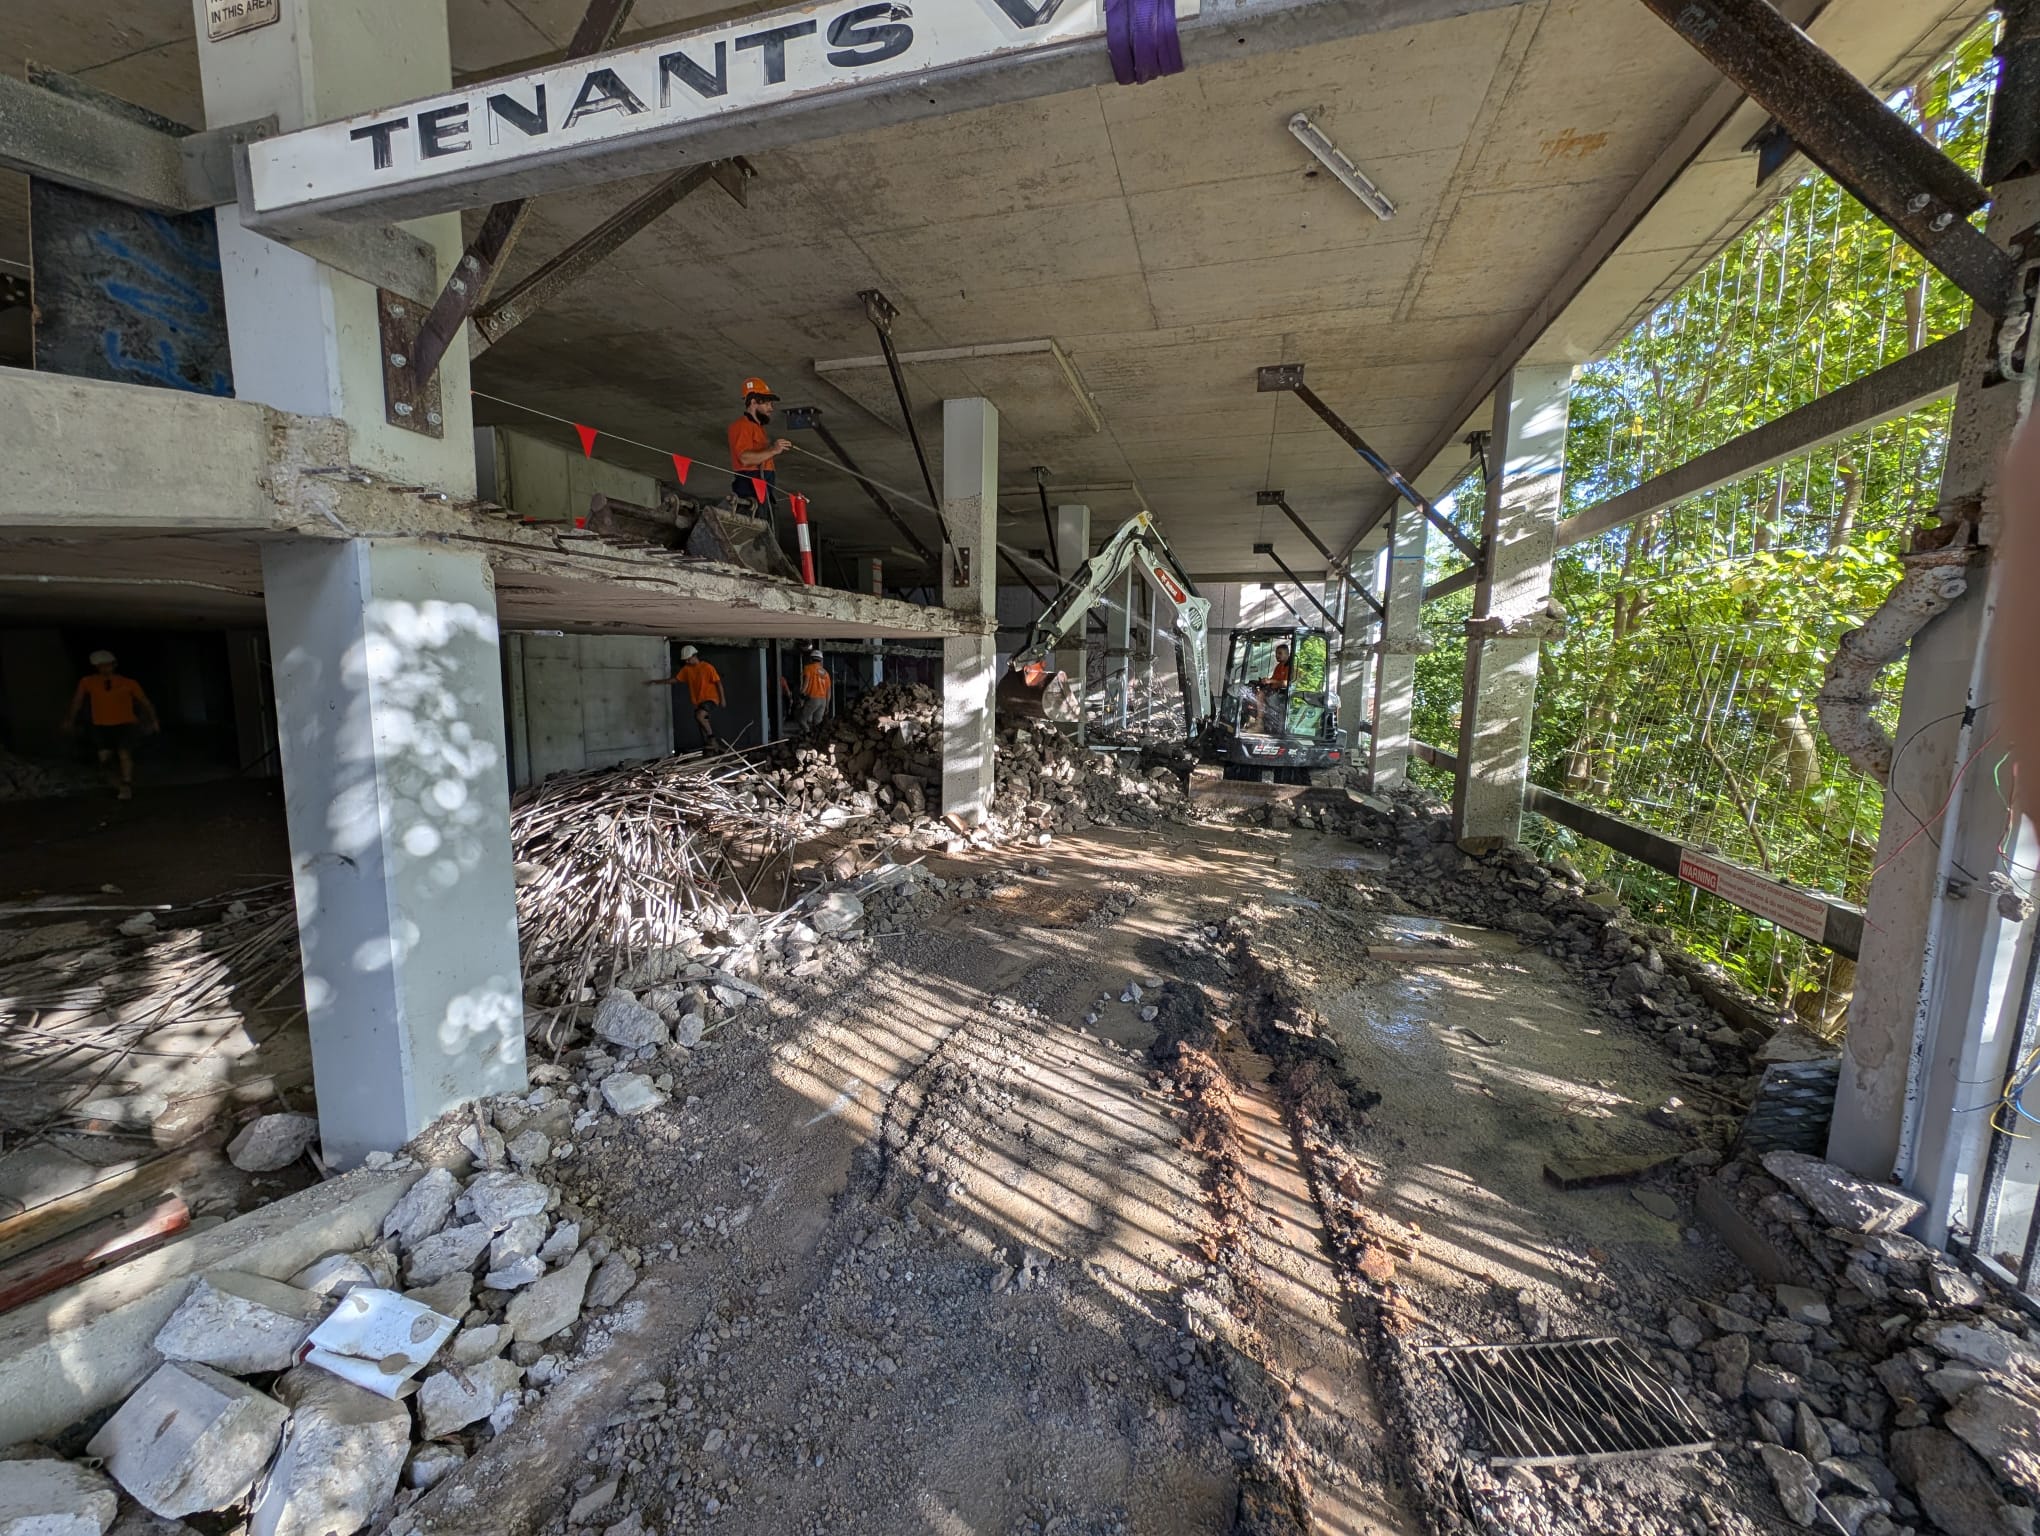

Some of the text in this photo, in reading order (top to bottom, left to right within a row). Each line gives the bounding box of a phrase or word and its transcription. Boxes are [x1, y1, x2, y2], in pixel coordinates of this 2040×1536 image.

[211, 0, 273, 24] IN THIS AREA
[350, 2, 914, 171] TENANTS
[1681, 862, 1717, 889] WARNING
